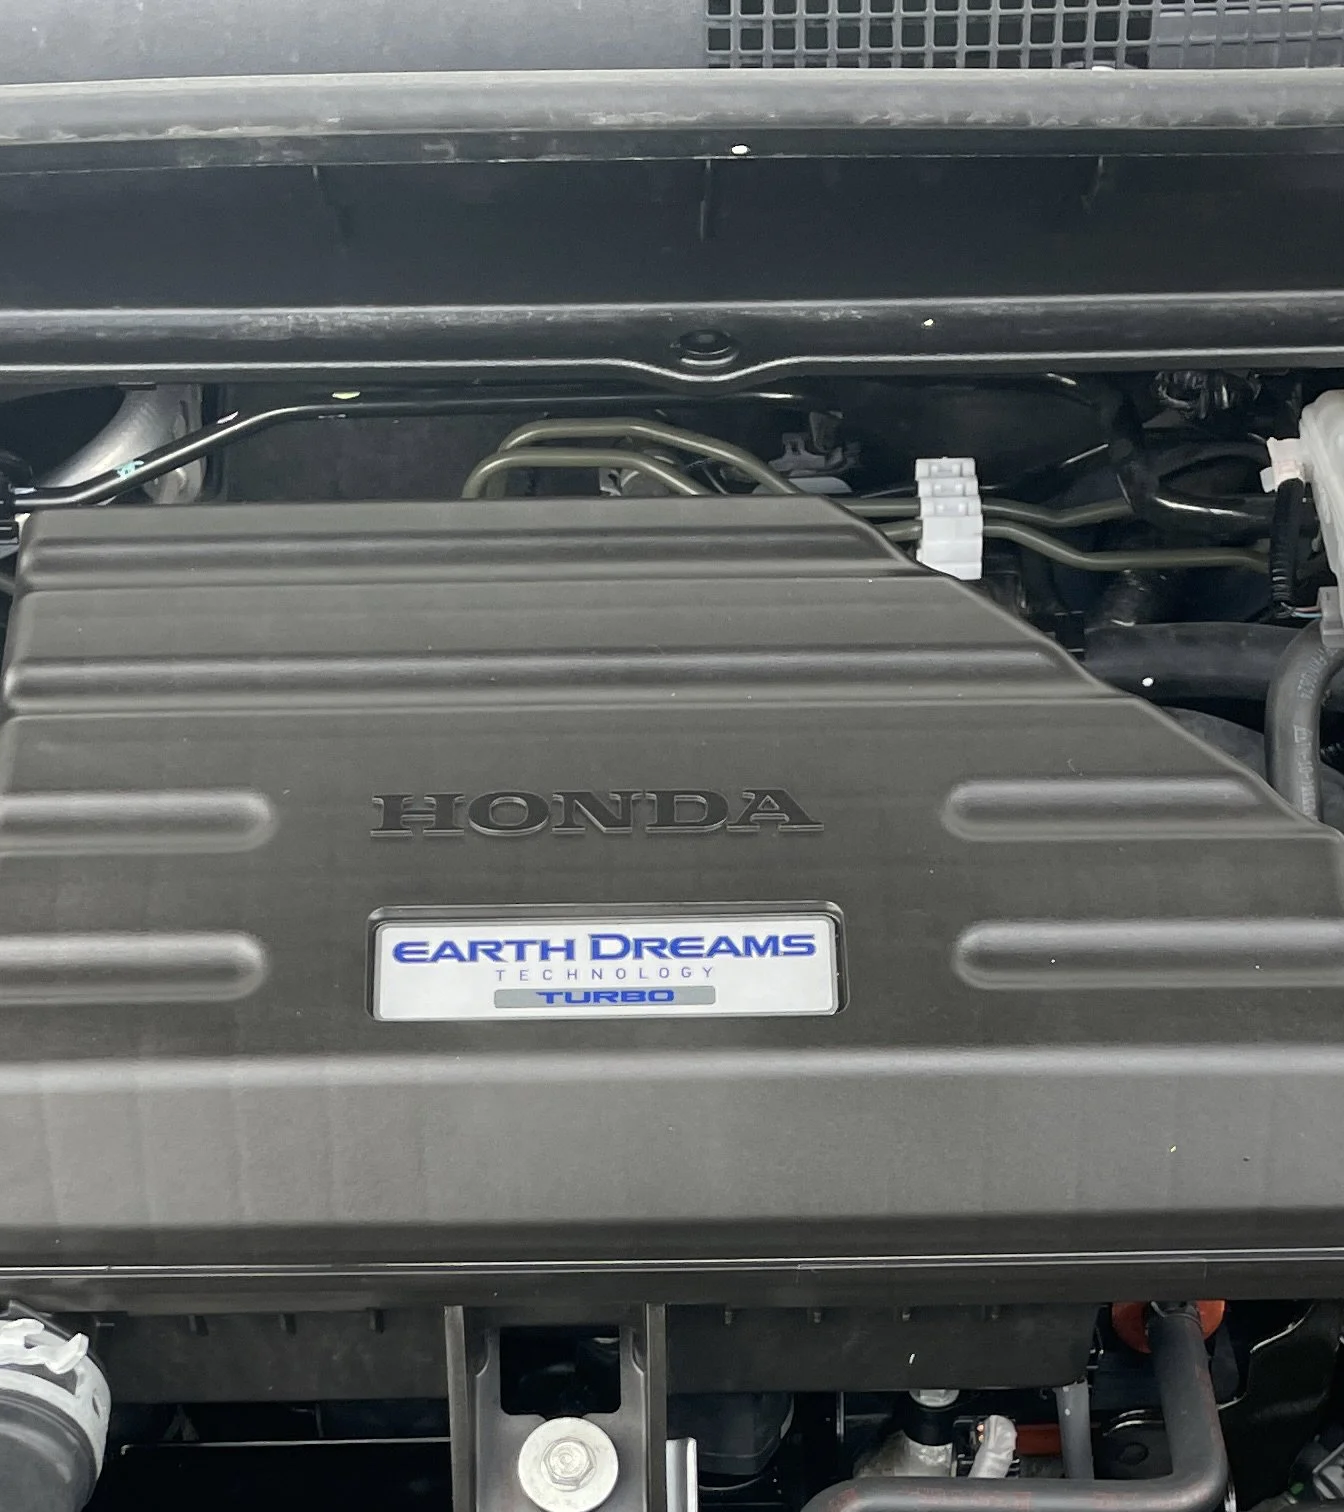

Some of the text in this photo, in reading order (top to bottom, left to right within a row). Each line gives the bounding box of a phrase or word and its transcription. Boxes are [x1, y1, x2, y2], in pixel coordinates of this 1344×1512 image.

[370, 787, 825, 838] HONDA
[392, 932, 817, 964] EARTH DREAMS
[496, 965, 716, 982] TECHNOLOGY
[535, 989, 675, 1004] TURBO
